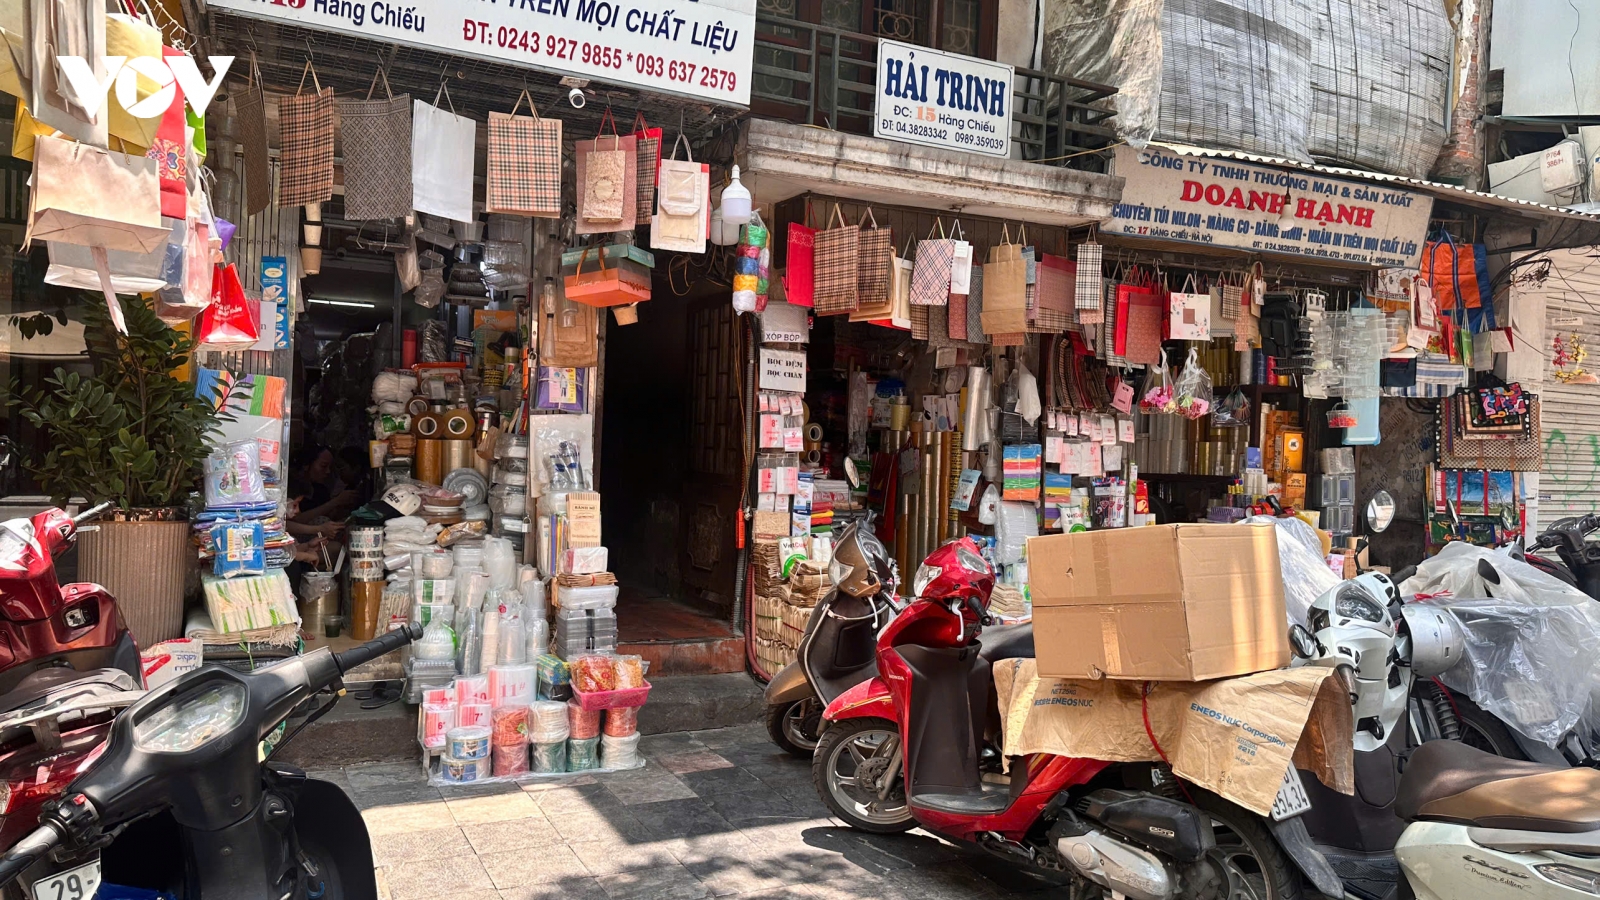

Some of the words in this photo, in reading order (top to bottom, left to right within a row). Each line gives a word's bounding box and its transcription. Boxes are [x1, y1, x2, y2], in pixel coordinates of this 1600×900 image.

[370, 4, 425, 33] Chiếu
[575, 0, 620, 31] MỌI
[625, 9, 685, 42] CHẤT
[690, 21, 738, 54] LIỆU
[463, 19, 491, 45] ĐT:
[497, 26, 540, 53] 0243
[546, 35, 577, 61] 927
[581, 42, 622, 69] 9855
[636, 53, 663, 77] 093
[669, 59, 696, 83] 637
[700, 66, 736, 92] 2579
[884, 51, 929, 103] HẢI
[934, 68, 1006, 117] TRINH
[882, 118, 894, 130] ĐT:
[896, 122, 948, 140] 04.38283342
[954, 132, 1004, 149] 0989.359039
[893, 105, 912, 118] ĐC:
[916, 105, 936, 122] 15
[938, 113, 965, 130] Hàng
[967, 118, 995, 133] Chiếu
[1140, 151, 1183, 170] CÔNG
[1212, 164, 1250, 181] TNHH
[1253, 171, 1308, 190] THƯƠNG
[1312, 181, 1338, 197] MẠI
[1341, 186, 1350, 197] &
[1353, 185, 1379, 202] SẢN
[1381, 191, 1413, 208] XUẤT
[1179, 179, 1286, 214] DOANH
[1294, 197, 1375, 228] HẠNH
[1112, 203, 1151, 221] CHUYÊN
[1154, 205, 1170, 224] TÚI
[1171, 210, 1202, 228] NILON
[1206, 213, 1234, 233] MÀNG
[1237, 219, 1250, 235] CO
[1254, 219, 1279, 238] BĂNG
[1308, 228, 1332, 248] NHẬN
[1332, 232, 1342, 246] IN
[1343, 232, 1363, 249] TRÊN
[1363, 236, 1379, 254] MỌI
[1380, 236, 1400, 254] CHẤT
[1400, 240, 1417, 259] LIỆU
[1137, 226, 1149, 235] 17
[1150, 226, 1169, 237] HÀNG
[1078, 699, 1094, 707] NUC
[1190, 702, 1222, 720] ENEOS
[1222, 715, 1242, 728] NUC
[1242, 722, 1286, 748] Corporation
